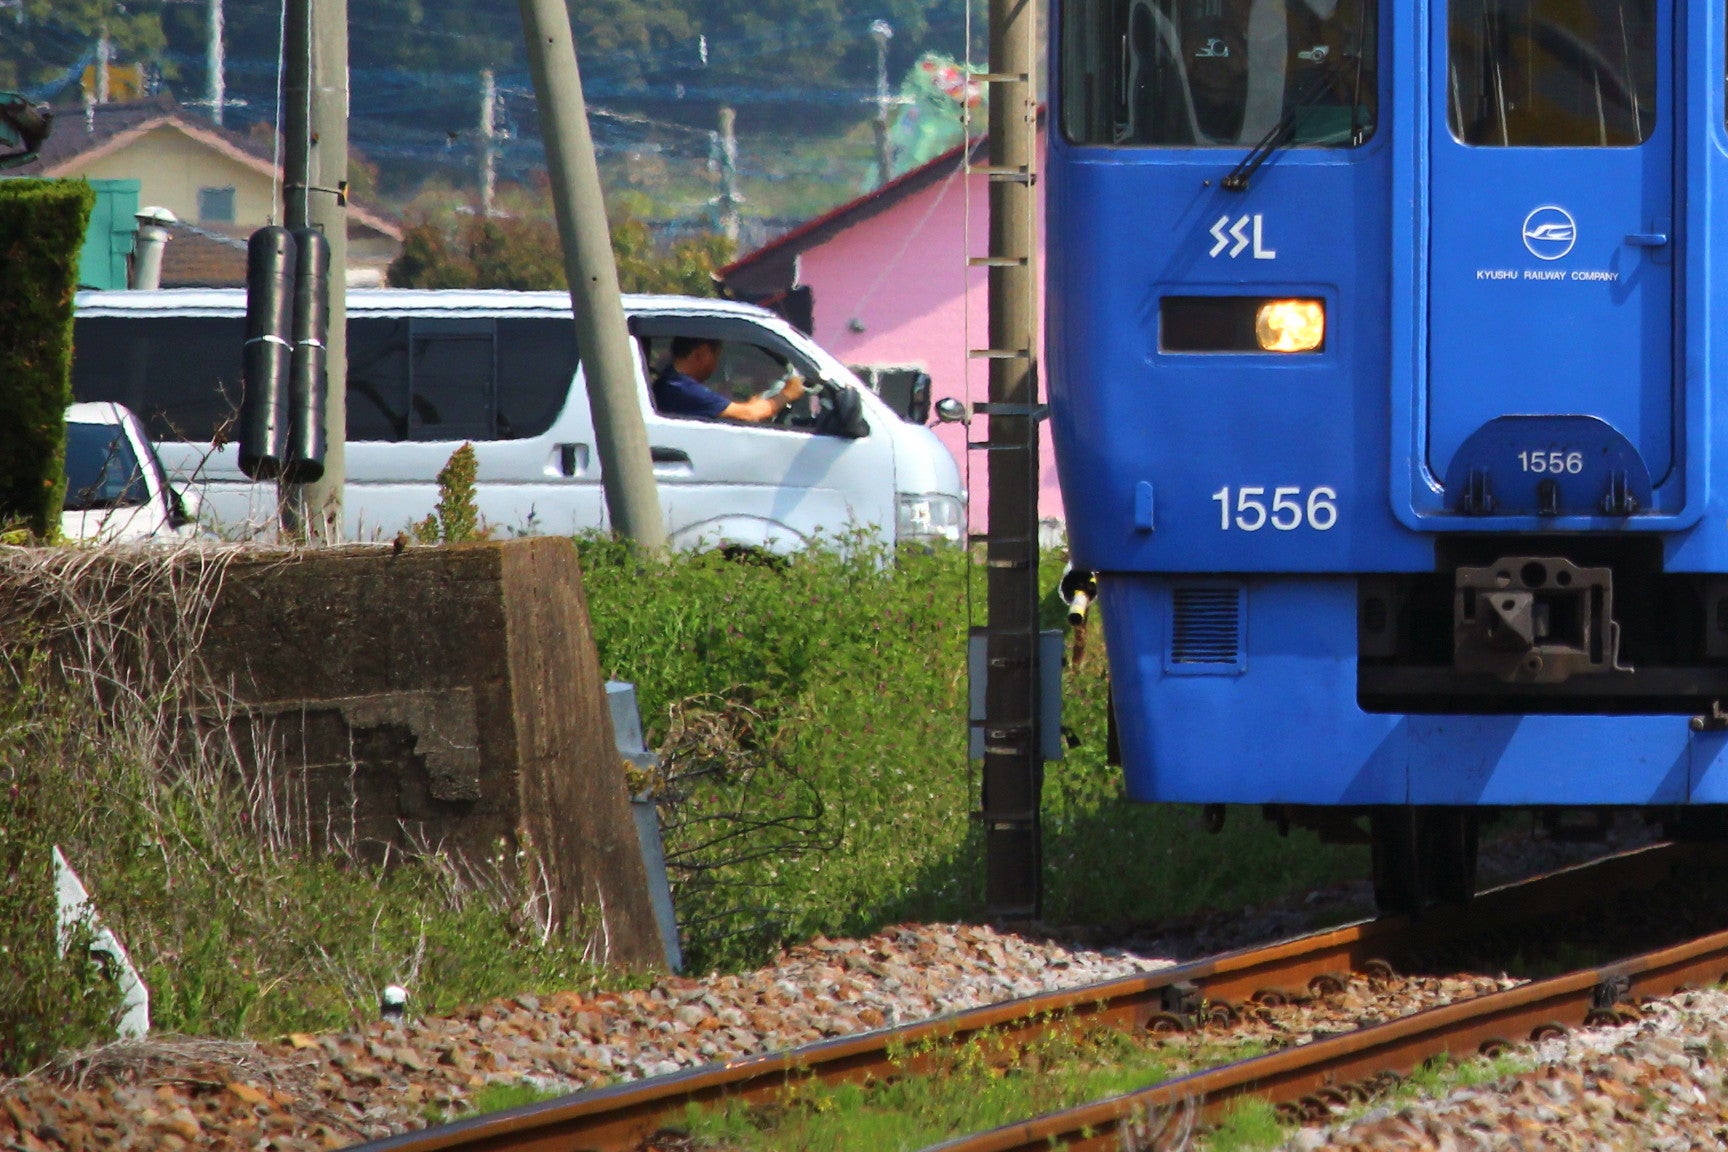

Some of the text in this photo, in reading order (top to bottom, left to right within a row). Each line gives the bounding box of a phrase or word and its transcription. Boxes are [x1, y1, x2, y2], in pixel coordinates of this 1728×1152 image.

[1209, 215, 1276, 259] SSL
[1476, 270, 1619, 281] KYUSHU RAILWAY COMPANY
[1518, 451, 1583, 474] 1556
[1212, 487, 1337, 531] 1556
